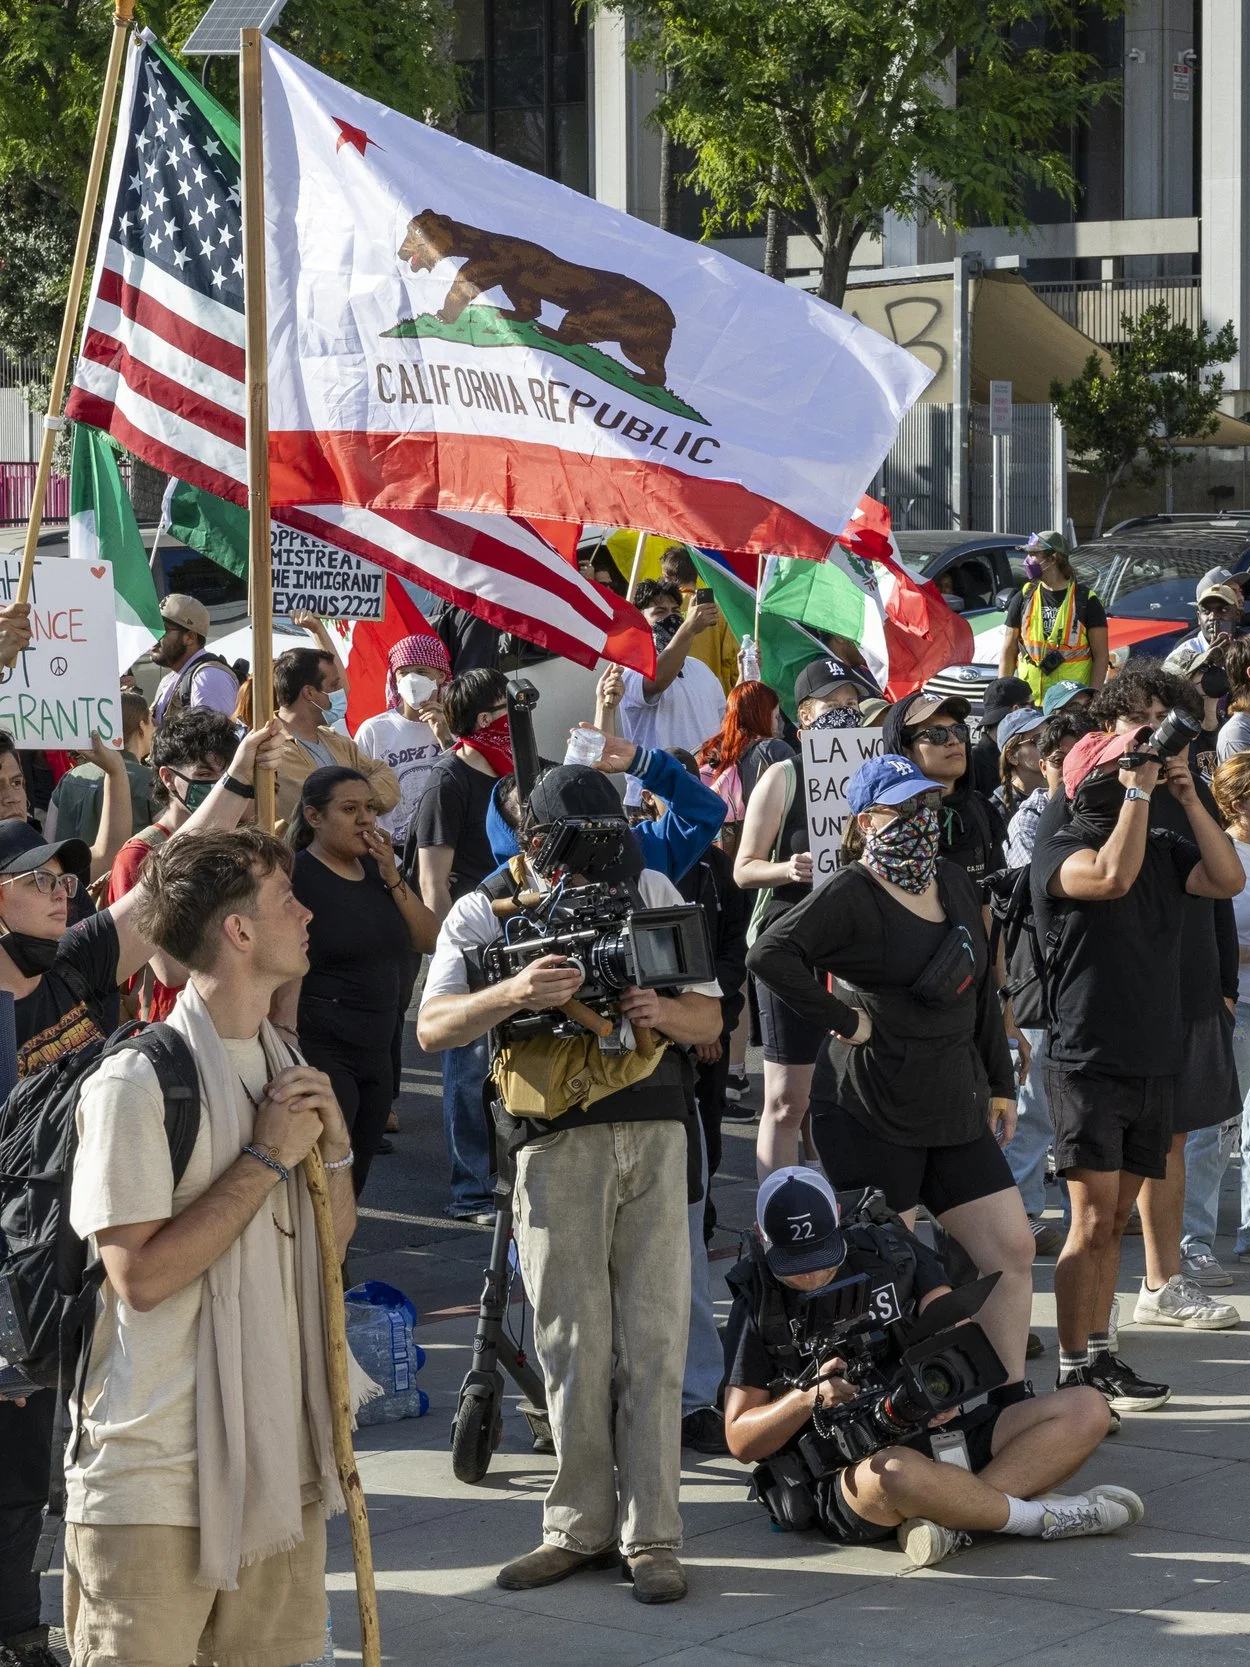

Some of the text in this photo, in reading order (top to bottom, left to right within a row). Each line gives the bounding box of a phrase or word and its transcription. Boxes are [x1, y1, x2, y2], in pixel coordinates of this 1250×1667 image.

[376, 362, 721, 465] CALIFORNIA REPUBLIC
[292, 569, 382, 594] IMMIGRANT
[272, 591, 339, 617] EXODUS
[825, 660, 845, 677] LA
[809, 737, 848, 764] LA
[887, 760, 915, 776] LA
[790, 1221, 816, 1241] 22
